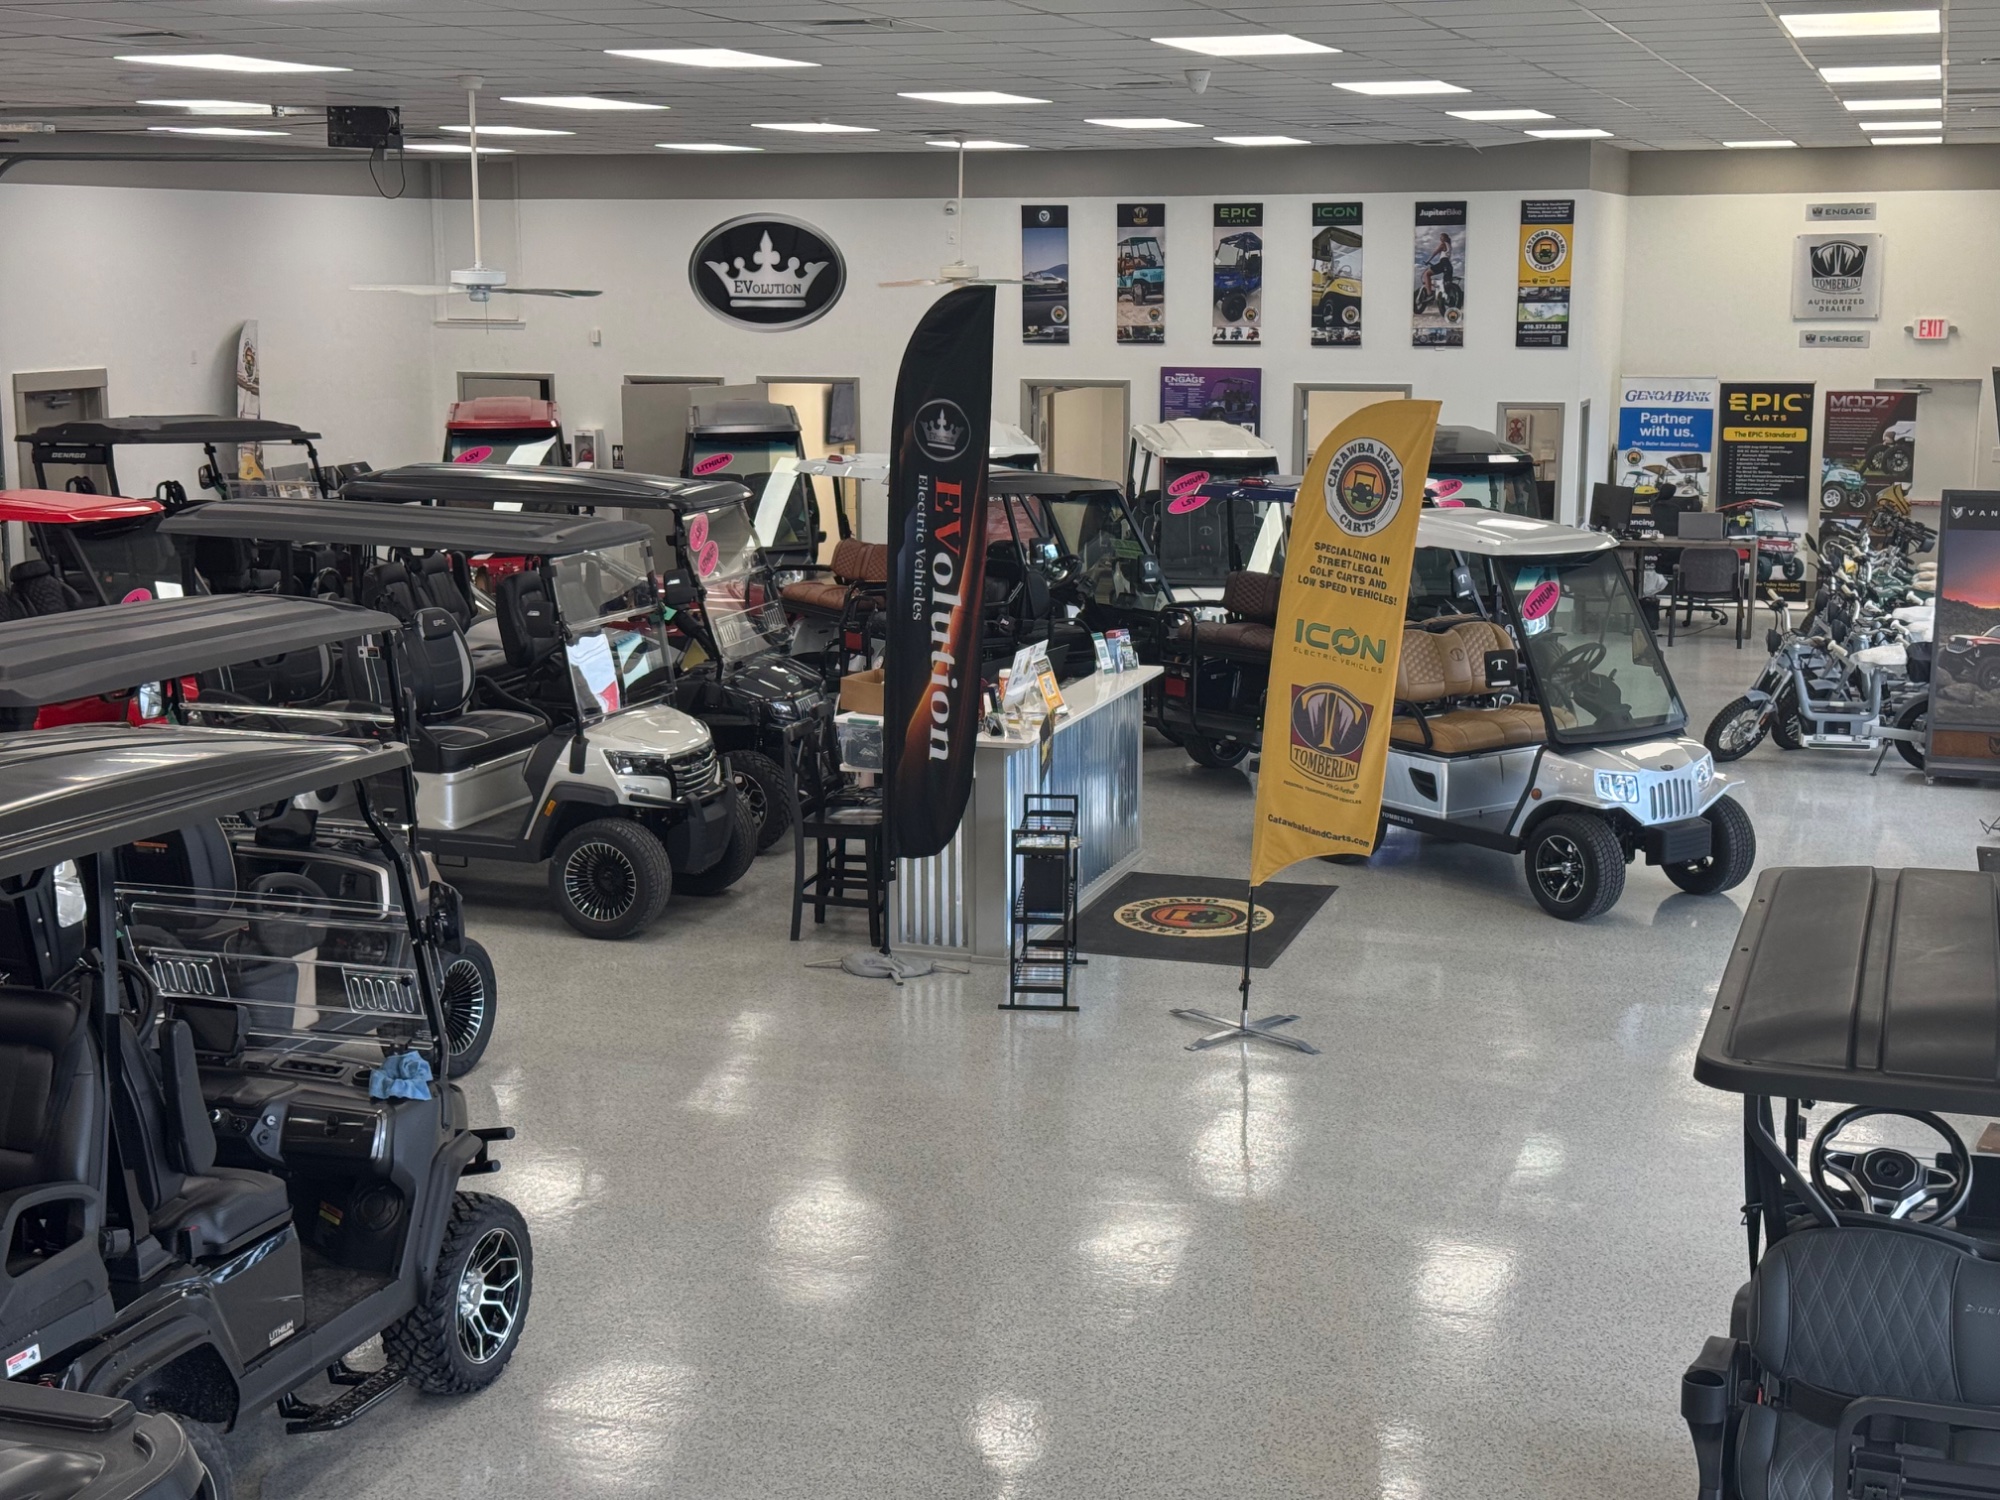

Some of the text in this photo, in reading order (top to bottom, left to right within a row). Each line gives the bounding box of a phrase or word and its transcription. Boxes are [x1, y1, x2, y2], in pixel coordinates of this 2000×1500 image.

[1220, 208, 1257, 218] EPIC
[1317, 207, 1357, 217] ICON
[1825, 207, 1871, 216] ENGAGE
[1814, 277, 1861, 291] TOMBERLIN
[1808, 298, 1865, 306] AUTHORIZED
[1818, 305, 1853, 313] DEALER
[1919, 319, 1945, 338] EXIT
[1819, 334, 1864, 343] E-MERGE
[1164, 376, 1206, 384] ENGAGE
[1728, 393, 1804, 412] EPIC
[1830, 395, 1890, 409] MODZ
[1640, 412, 1694, 425] Partner
[1744, 414, 1788, 422] CARTS
[1640, 425, 1695, 438] with us.
[1765, 431, 1797, 439] Standard
[464, 451, 479, 462] LSV
[696, 454, 729, 473] LITHIUM
[1327, 442, 1401, 501] CATAWBA ISLAND
[1172, 473, 1206, 493] LITHIUM
[1181, 496, 1196, 507] LSV
[1339, 514, 1377, 533] CARTS
[912, 473, 929, 622] Electric Vehicles
[1314, 541, 1391, 566] SPECIALIZING IN
[1317, 554, 1384, 577] STREET LEGAL
[1309, 565, 1388, 590] GOLF CARTS AND
[1297, 575, 1398, 606] LOW SPEED VEHICLES!
[1526, 583, 1557, 617] LITHIUM
[1295, 618, 1387, 664] ICON
[1293, 646, 1383, 674] ELECTRIC VEHICLES
[1293, 747, 1356, 779] TOMBERLIN
[1267, 813, 1370, 848] CatawbaIslandCarts.com
